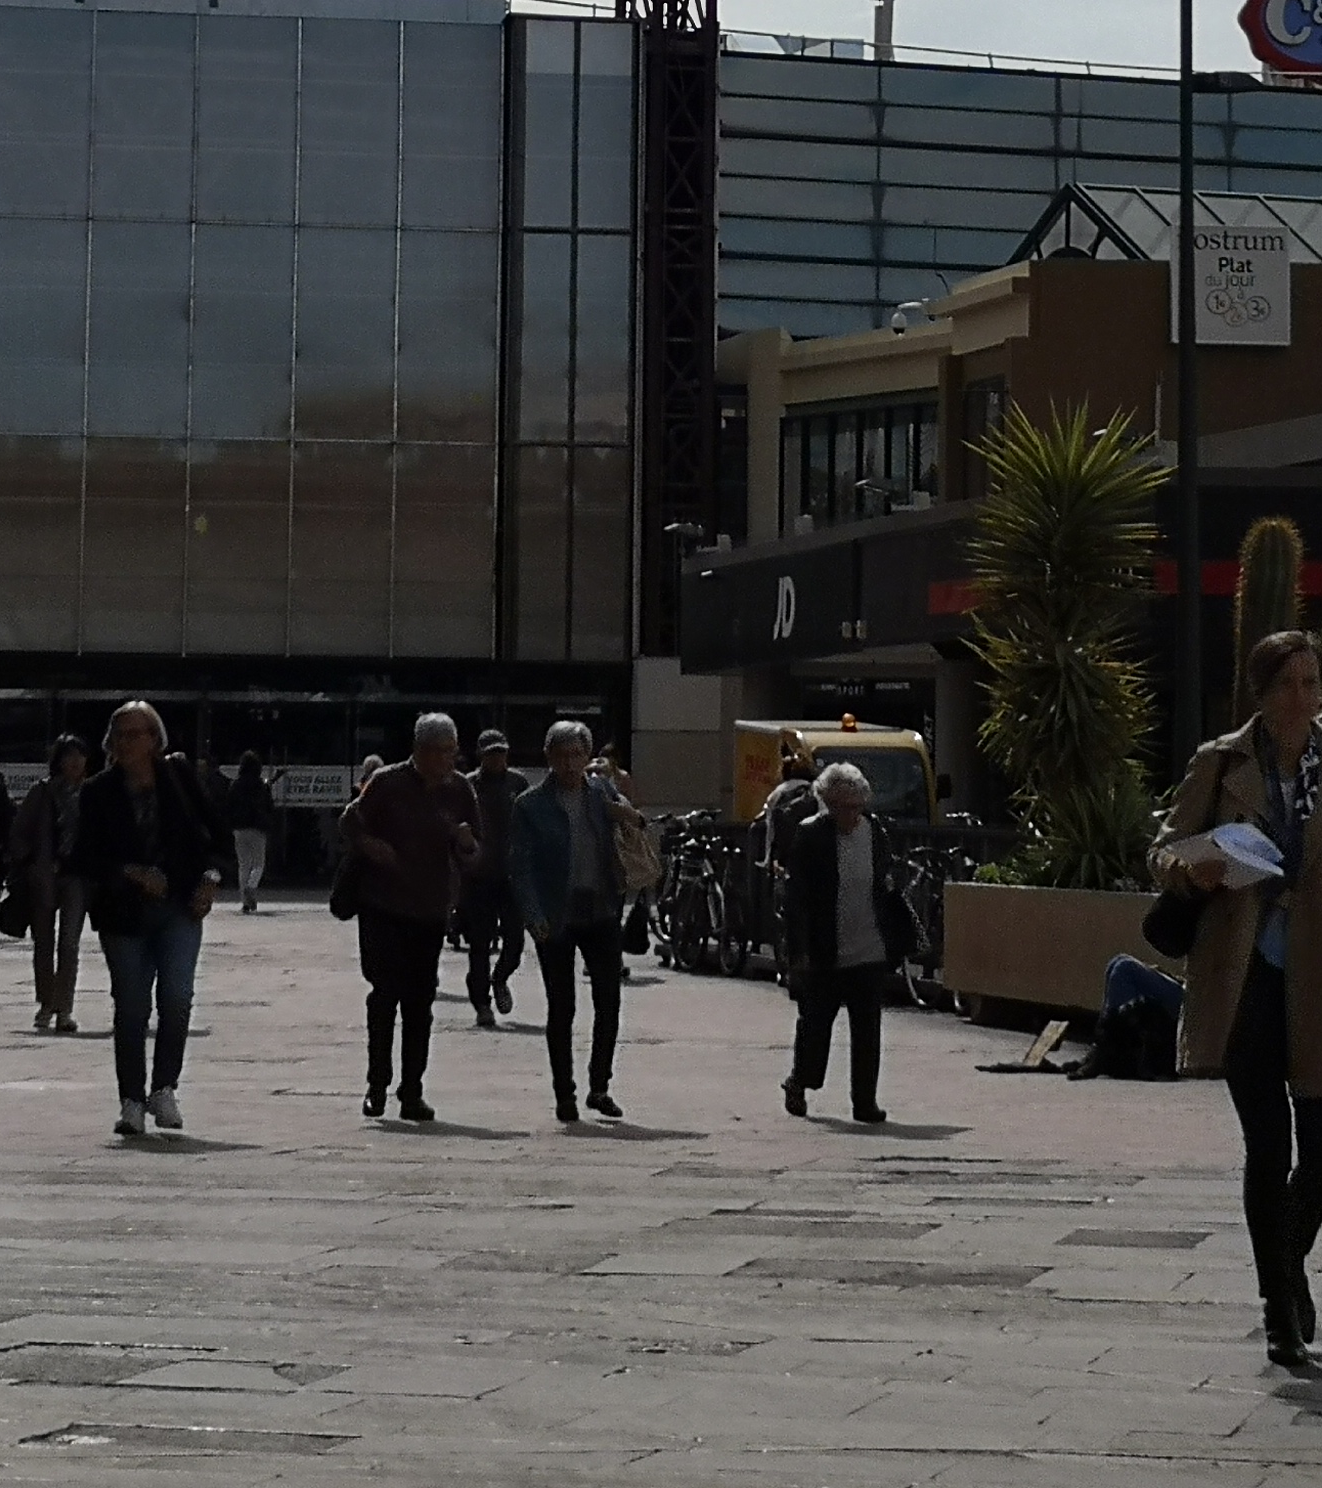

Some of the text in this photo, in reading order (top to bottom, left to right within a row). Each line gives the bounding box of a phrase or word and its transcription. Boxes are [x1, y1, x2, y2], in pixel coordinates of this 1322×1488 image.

[1193, 231, 1285, 251] ostrum
[1218, 256, 1254, 273] Plat
[1224, 272, 1256, 290] jour
